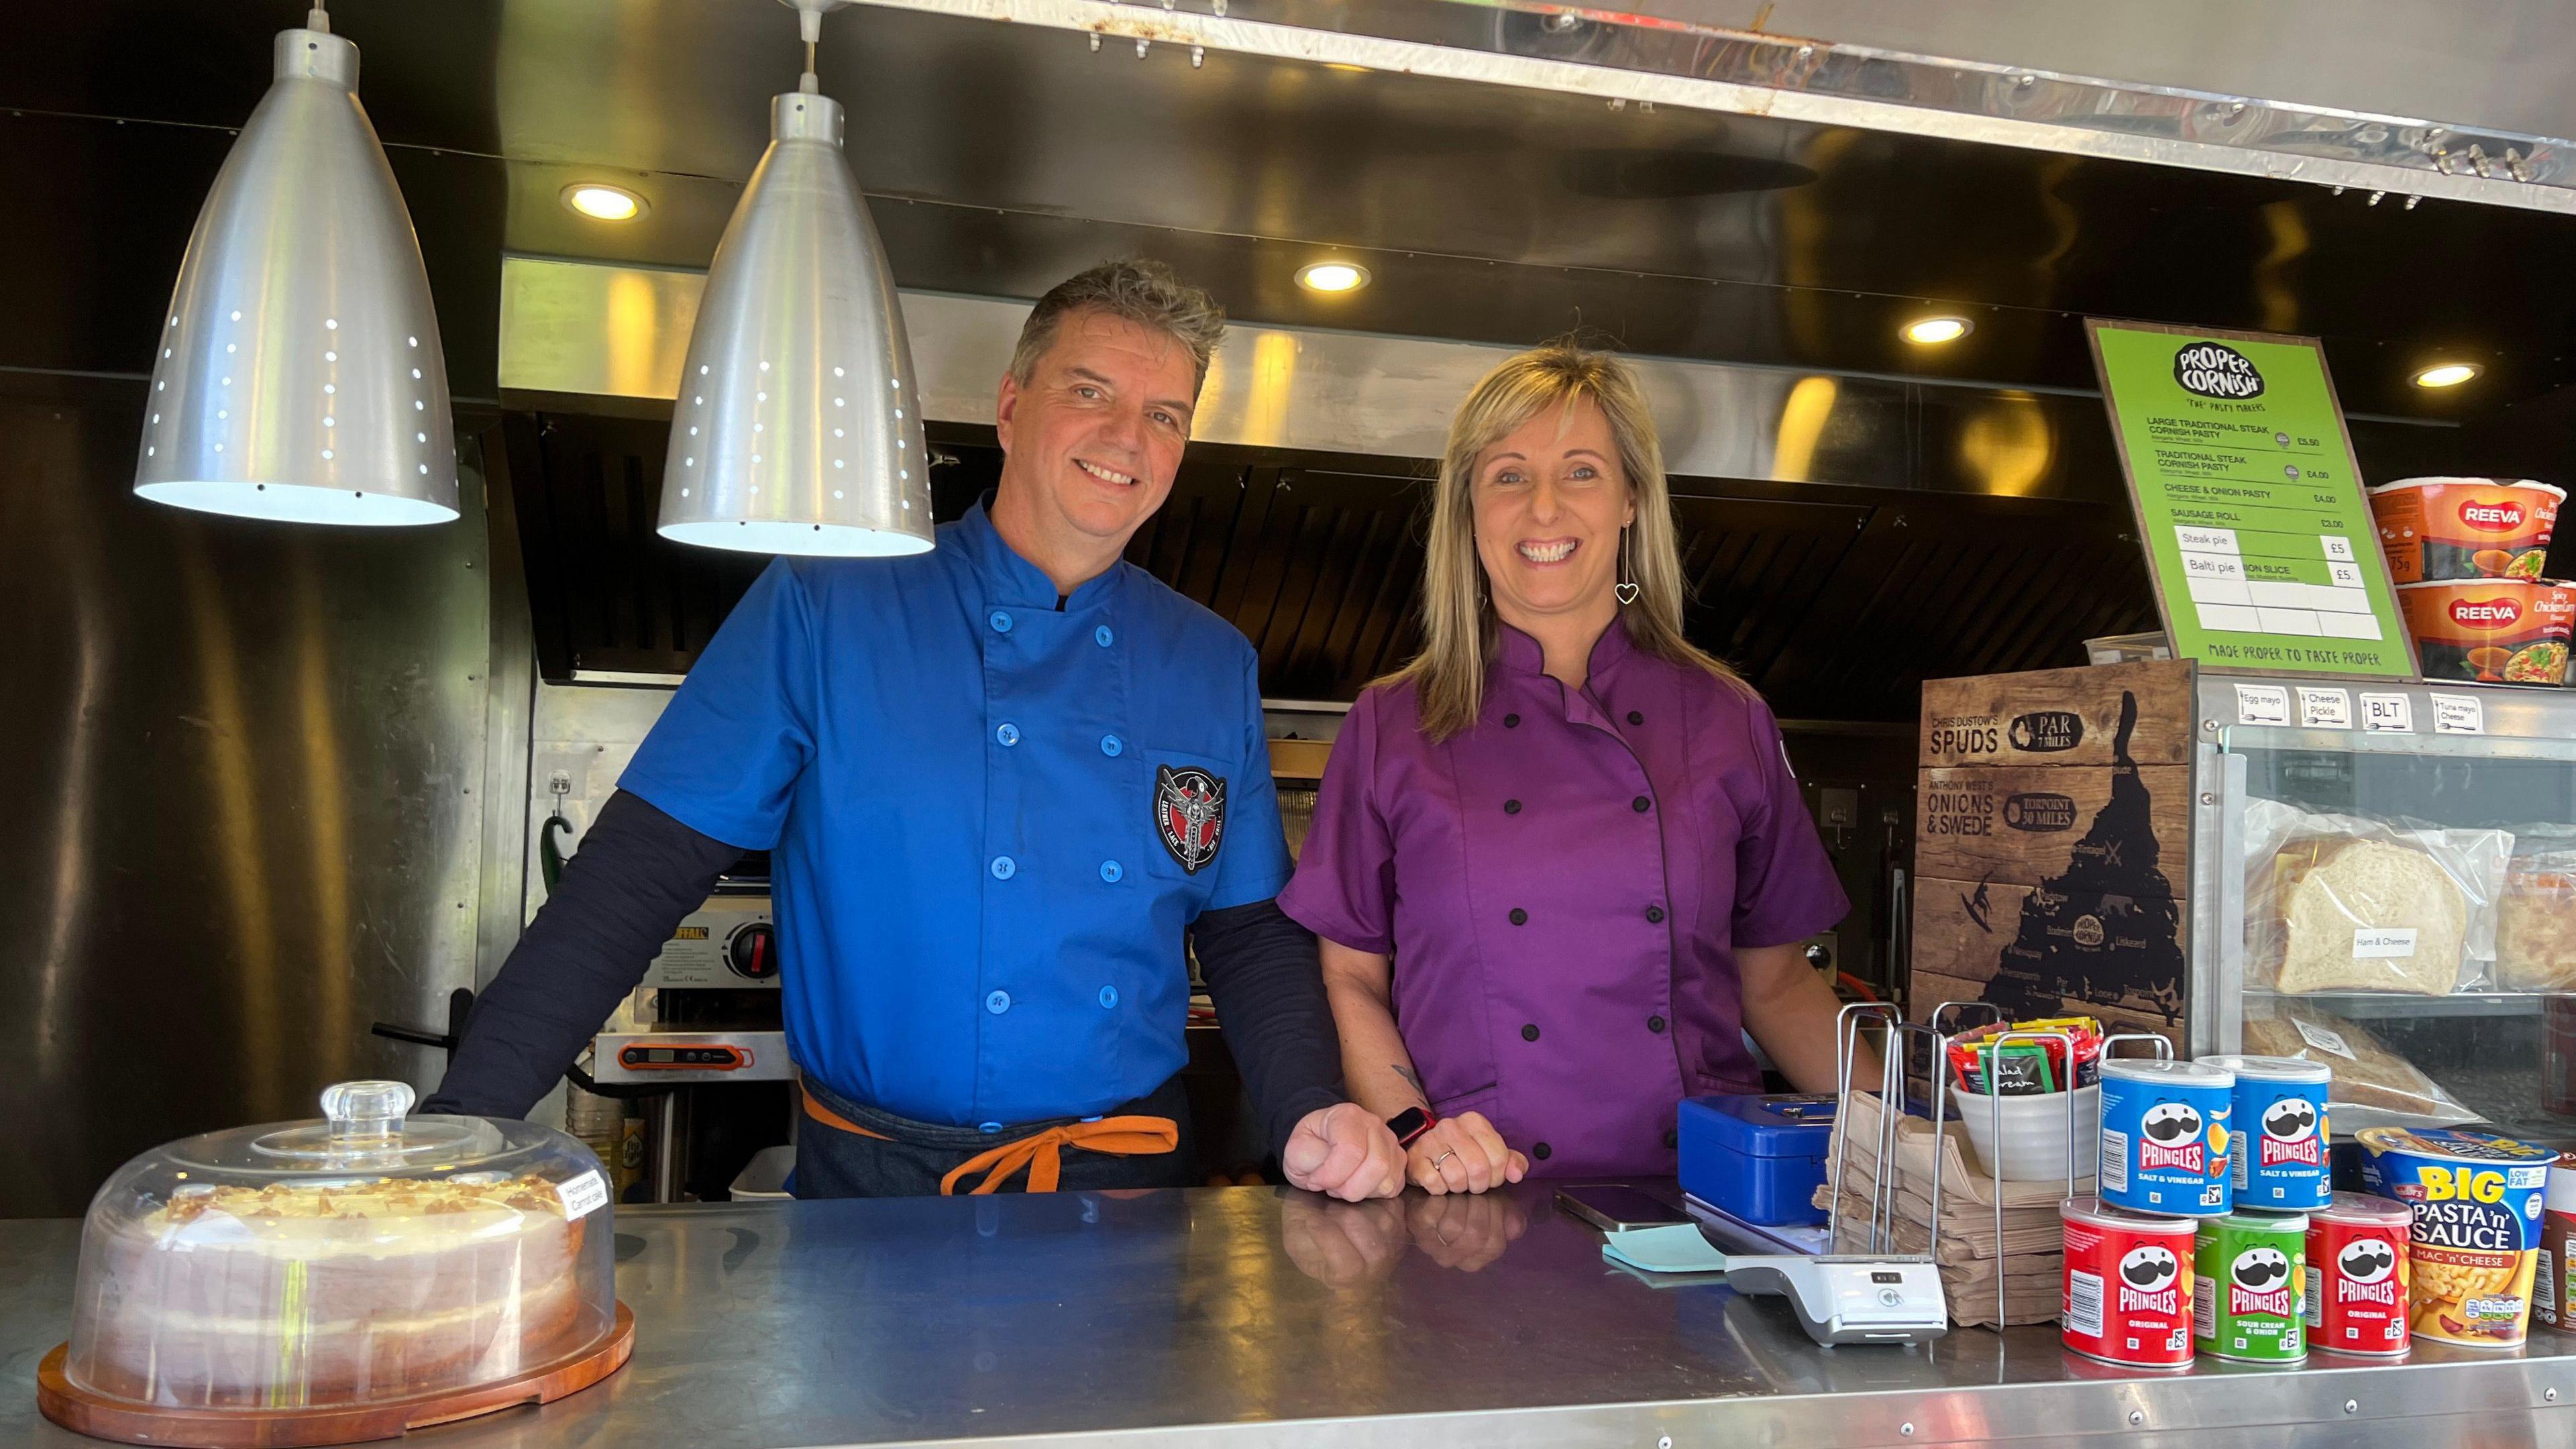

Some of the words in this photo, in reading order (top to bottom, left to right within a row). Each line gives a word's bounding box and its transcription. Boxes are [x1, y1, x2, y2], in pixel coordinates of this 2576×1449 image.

[2180, 347, 2253, 376] PROPER
[2210, 402, 2233, 412] PASTY
[2237, 403, 2266, 412] MAKERS
[2147, 417, 2178, 427] LARGE
[2179, 419, 2238, 432] TRADITIONAL
[2239, 425, 2269, 434] STEAK
[2149, 426, 2190, 437] CORNISH
[2192, 429, 2220, 438] PASTY
[2298, 437, 2320, 447] £5.50
[2155, 450, 2215, 462] TRADITIONAL
[2216, 455, 2247, 464] STEAK
[2157, 460, 2200, 470] CORNISH
[2201, 462, 2230, 471] PASTY
[2307, 470, 2330, 480] £4.00
[2164, 484, 2201, 494] CHEESE
[2202, 486, 2210, 494] &
[2211, 487, 2241, 496] ONION
[2243, 490, 2271, 499] PASTY
[2314, 494, 2337, 504] £4.00
[2171, 508, 2215, 519] SAUSAGE
[2216, 512, 2241, 521] ROLL
[2465, 507, 2521, 524] REEVA
[2321, 519, 2344, 529] £3.00
[2182, 533, 2210, 545] Steak
[2213, 535, 2228, 546] pie
[2330, 543, 2345, 554] £5
[2189, 559, 2215, 572] Balti
[2218, 561, 2235, 575] pie
[2263, 565, 2292, 575] SLICE
[2455, 606, 2516, 621] REEVA
[2208, 643, 2239, 658] MADE
[2243, 645, 2283, 661] PROPER
[2285, 647, 2302, 662] TO
[2305, 649, 2339, 663] TASTE
[2343, 651, 2381, 666] PROPER
[2244, 694, 2259, 704] Egg
[2261, 696, 2281, 706] mayo
[2309, 694, 2341, 704] Cheese
[2310, 706, 2336, 716] Pickle
[2371, 702, 2400, 717] BLT
[2440, 702, 2457, 711] Tuna
[2458, 706, 2476, 714] mayo
[1932, 716, 1955, 728] CHRIS
[1956, 714, 1998, 727] DUSTOW'S
[2441, 712, 2465, 721] Cheese
[2039, 714, 2071, 734] PAR
[1931, 728, 1998, 755] SPUDS
[2038, 737, 2043, 747] 7
[2044, 735, 2071, 748] MILES
[1929, 780, 1963, 791] ANTHONY
[1965, 780, 1994, 791] WEST'S
[1928, 793, 1994, 814] ONIONS
[2024, 798, 2072, 810] TORPOINT
[1161, 800, 1170, 826] LEATHER
[1167, 830, 1179, 847] LACE
[2022, 811, 2035, 825] 30
[2036, 811, 2072, 826] MILES
[1927, 814, 1937, 834] &
[1939, 815, 1993, 837] SWEDE
[2375, 937, 2381, 945] &
[2383, 937, 2410, 945] Cheese
[1998, 1064, 2023, 1076] alad
[1998, 1080, 2035, 1088] ream
[2141, 1141, 2202, 1171] PRINGLES
[2262, 1139, 2317, 1166] PRINGLES
[2138, 1173, 2159, 1183] SALT
[2159, 1175, 2166, 1183] &
[2167, 1177, 2204, 1185] VINEGAR
[2260, 1169, 2281, 1178] SALT
[2288, 1169, 2320, 1178] VINEGAR
[2510, 1170, 2529, 1178] LOW
[566, 1178, 600, 1197] Homemade
[2416, 1166, 2506, 1204] BIG
[2510, 1177, 2530, 1186] FAT
[572, 1195, 592, 1211] Carrot
[2414, 1203, 2487, 1224] PASTA
[2412, 1224, 2511, 1250] SAUCE
[2416, 1248, 2444, 1262] MAC
[2460, 1255, 2504, 1267] CHEESE
[2338, 1278, 2395, 1306] PRINGLES
[2119, 1286, 2177, 1316] PRINGLES
[2231, 1287, 2290, 1316] PRINGLES
[2347, 1309, 2387, 1320] ORIGINAL
[2128, 1319, 2169, 1330] ORIGINAL
[2236, 1320, 2259, 1329] SOUR
[2260, 1320, 2286, 1329] CREAM
[2245, 1328, 2252, 1336] &
[2253, 1328, 2279, 1336] ONION
